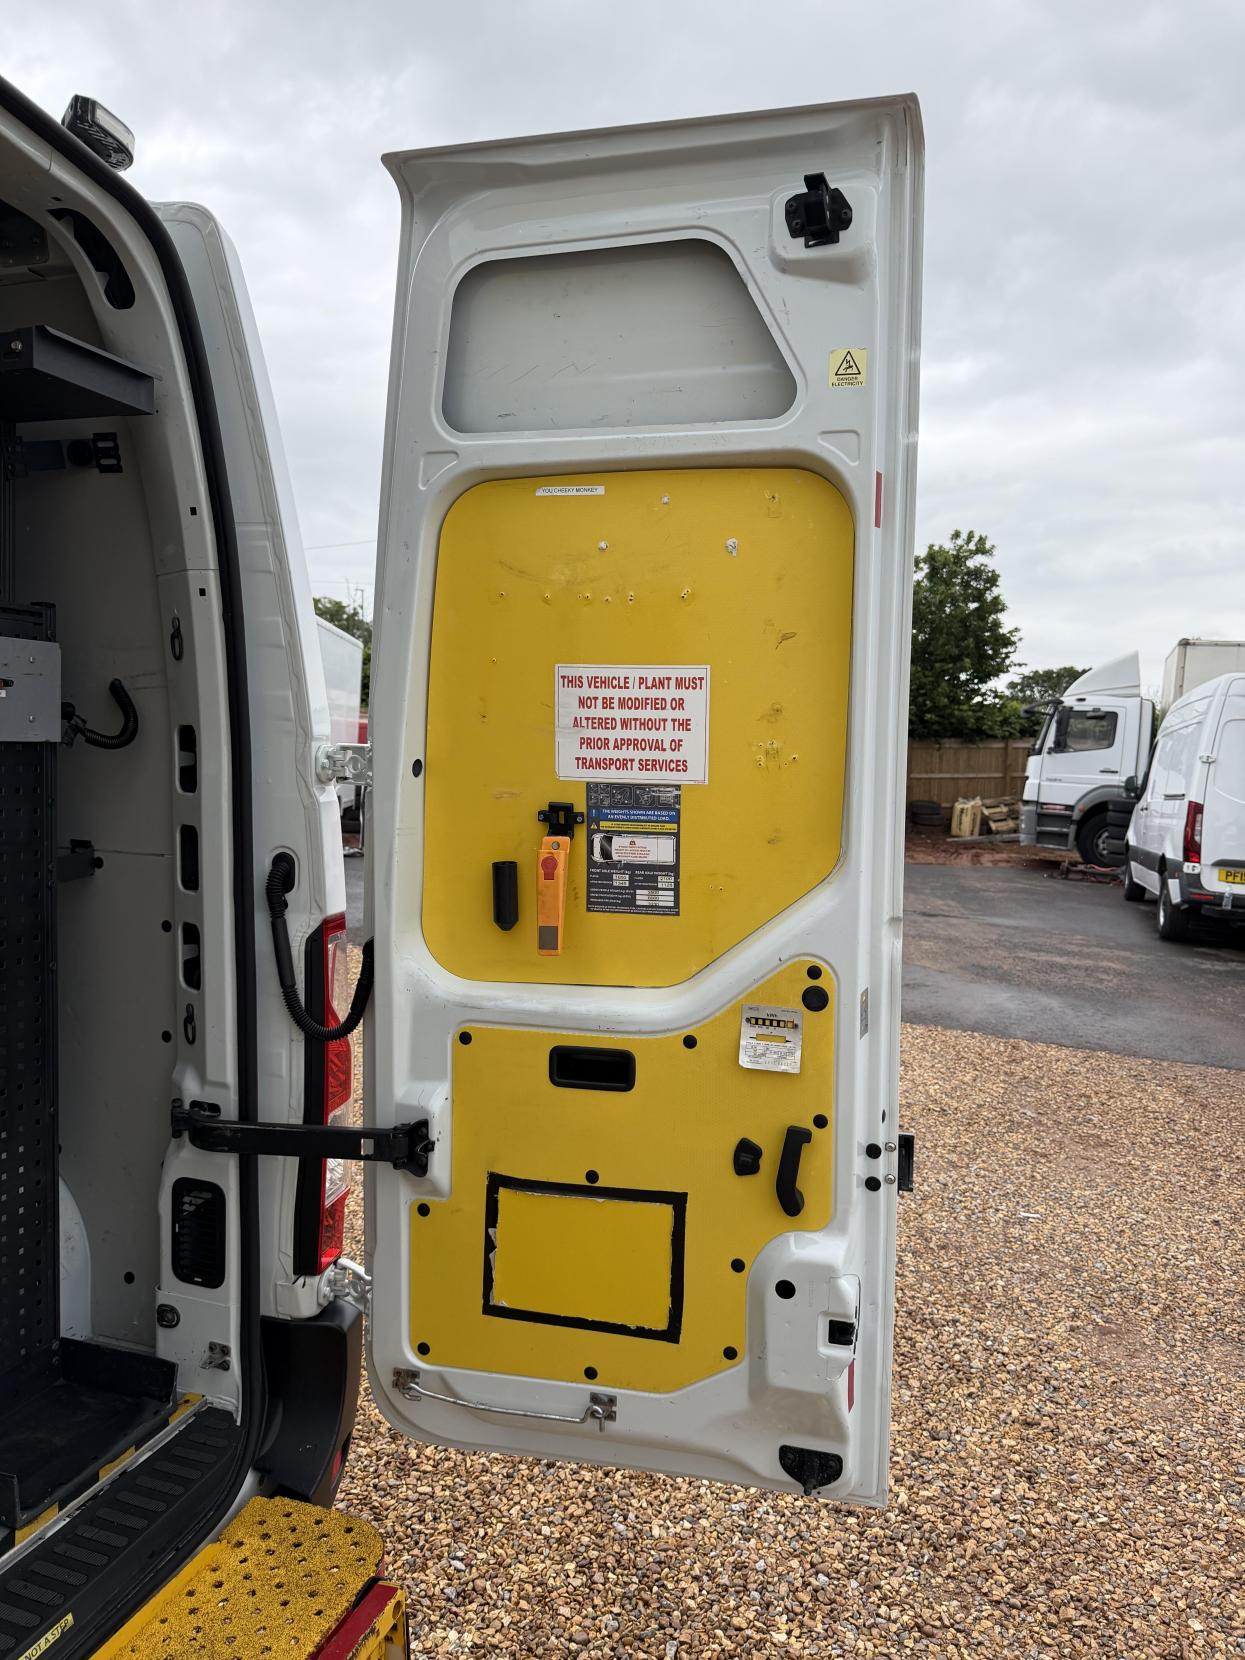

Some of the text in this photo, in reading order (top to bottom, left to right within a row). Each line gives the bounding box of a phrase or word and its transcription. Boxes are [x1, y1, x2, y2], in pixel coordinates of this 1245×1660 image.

[561, 675, 704, 690] THIS VEHICLE / PLANT MUST
[578, 696, 685, 710] NOT BE MODIFIED OR
[573, 716, 692, 732] ALTERED WITHOUT THE
[579, 737, 683, 752] PRIOR APPROVAL OF
[575, 757, 688, 772] TRANSPORT SERVICES
[1225, 870, 1245, 882] PF1
[24, 1642, 42, 1660] NOT
[44, 1637, 51, 1647] A
